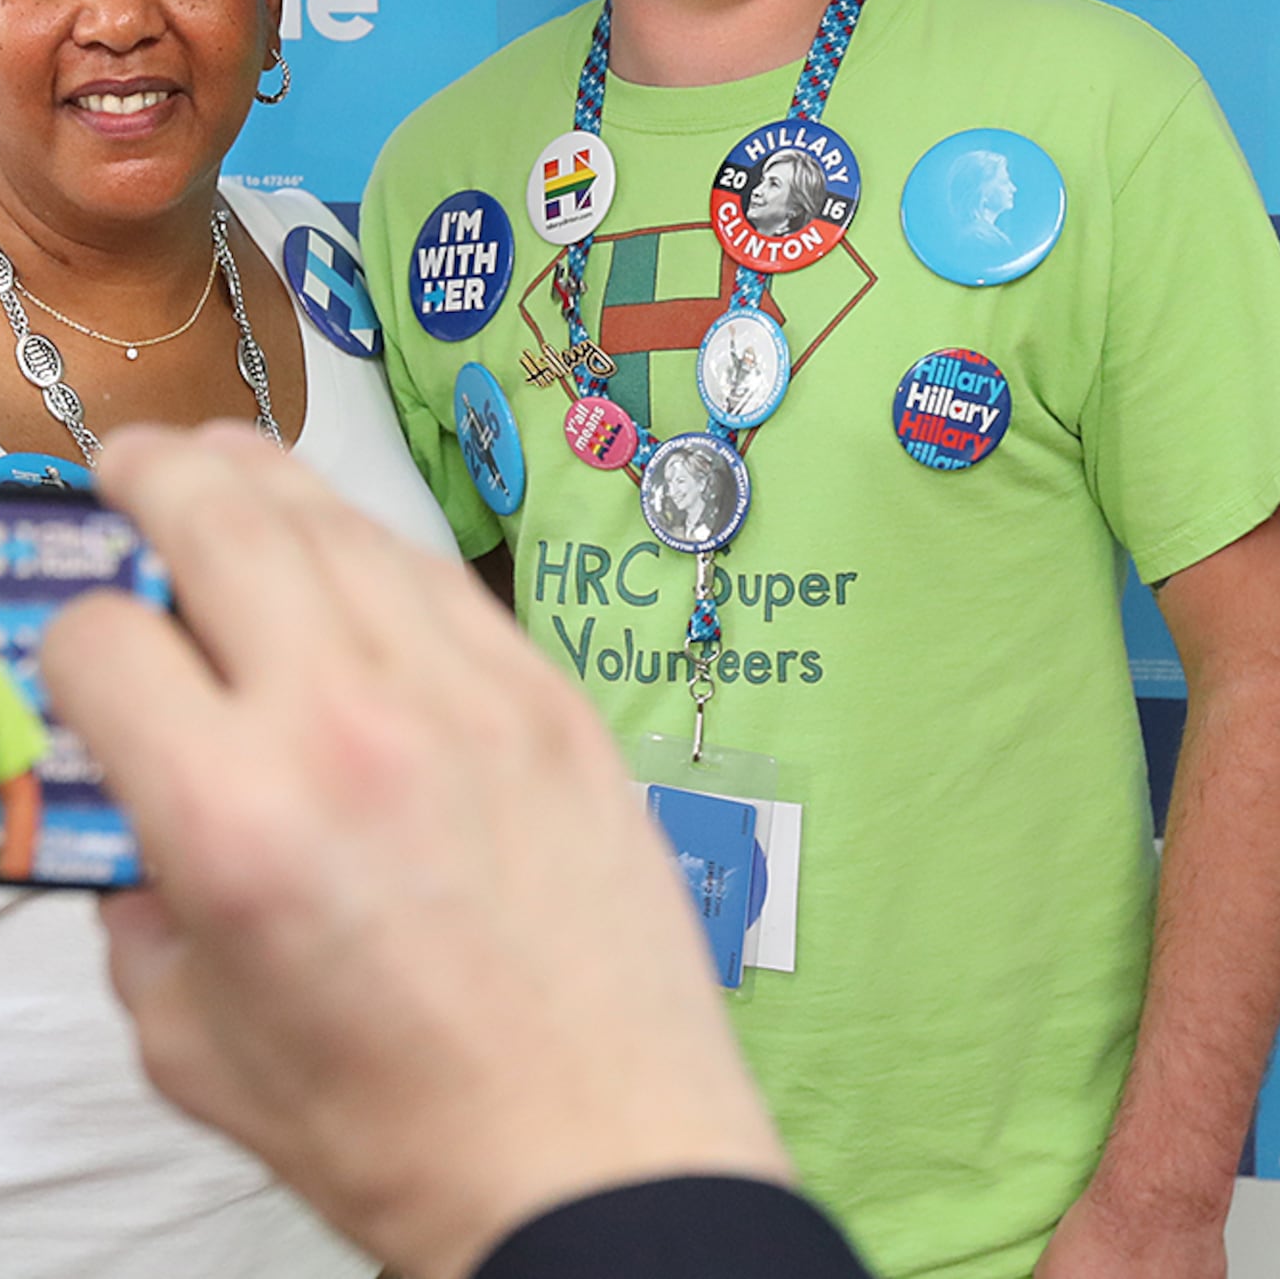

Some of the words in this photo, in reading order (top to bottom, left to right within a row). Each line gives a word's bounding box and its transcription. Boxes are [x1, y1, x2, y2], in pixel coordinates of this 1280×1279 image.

[720, 167, 748, 189] 20
[745, 127, 849, 183] HILLARY
[439, 208, 484, 244] I'M
[718, 202, 824, 262] CLINTON
[822, 198, 847, 220] 16
[418, 241, 498, 280] WITH
[422, 277, 486, 314] HER
[914, 356, 1006, 405] Hillary
[574, 406, 605, 451] means
[905, 381, 1000, 433] Hillary
[898, 410, 992, 461] Hillary
[536, 540, 660, 607] HRC
